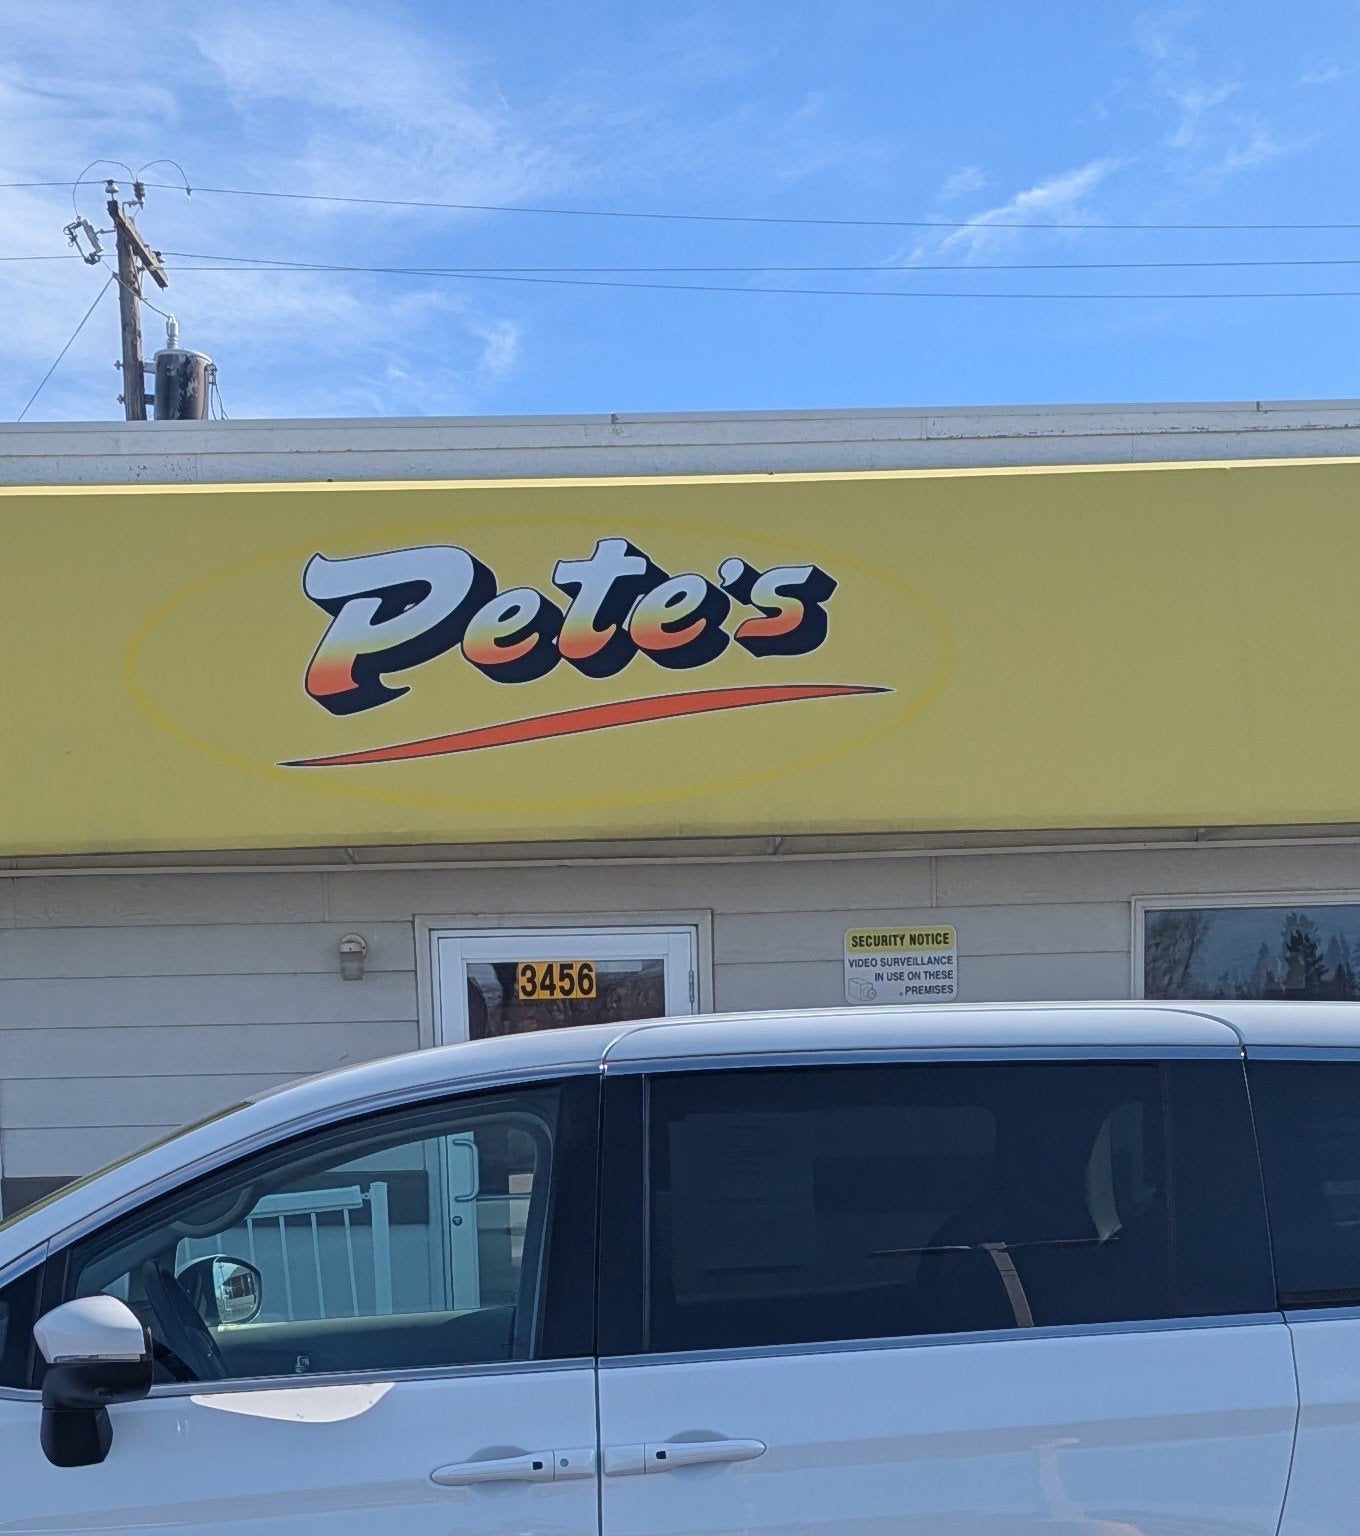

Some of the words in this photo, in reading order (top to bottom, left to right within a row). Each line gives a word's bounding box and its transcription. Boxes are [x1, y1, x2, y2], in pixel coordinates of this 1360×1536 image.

[302, 537, 838, 716] Pete's
[851, 933, 906, 948] SECURITY
[909, 932, 950, 946] NOTICE
[848, 957, 878, 968] VIDEO
[880, 955, 954, 968] SURVEILLANCE
[520, 962, 594, 997] 3456
[874, 972, 884, 982] IN
[886, 971, 905, 982] USE
[907, 971, 921, 981] ON
[923, 969, 954, 980] THESE
[904, 984, 954, 996] PREMISES
